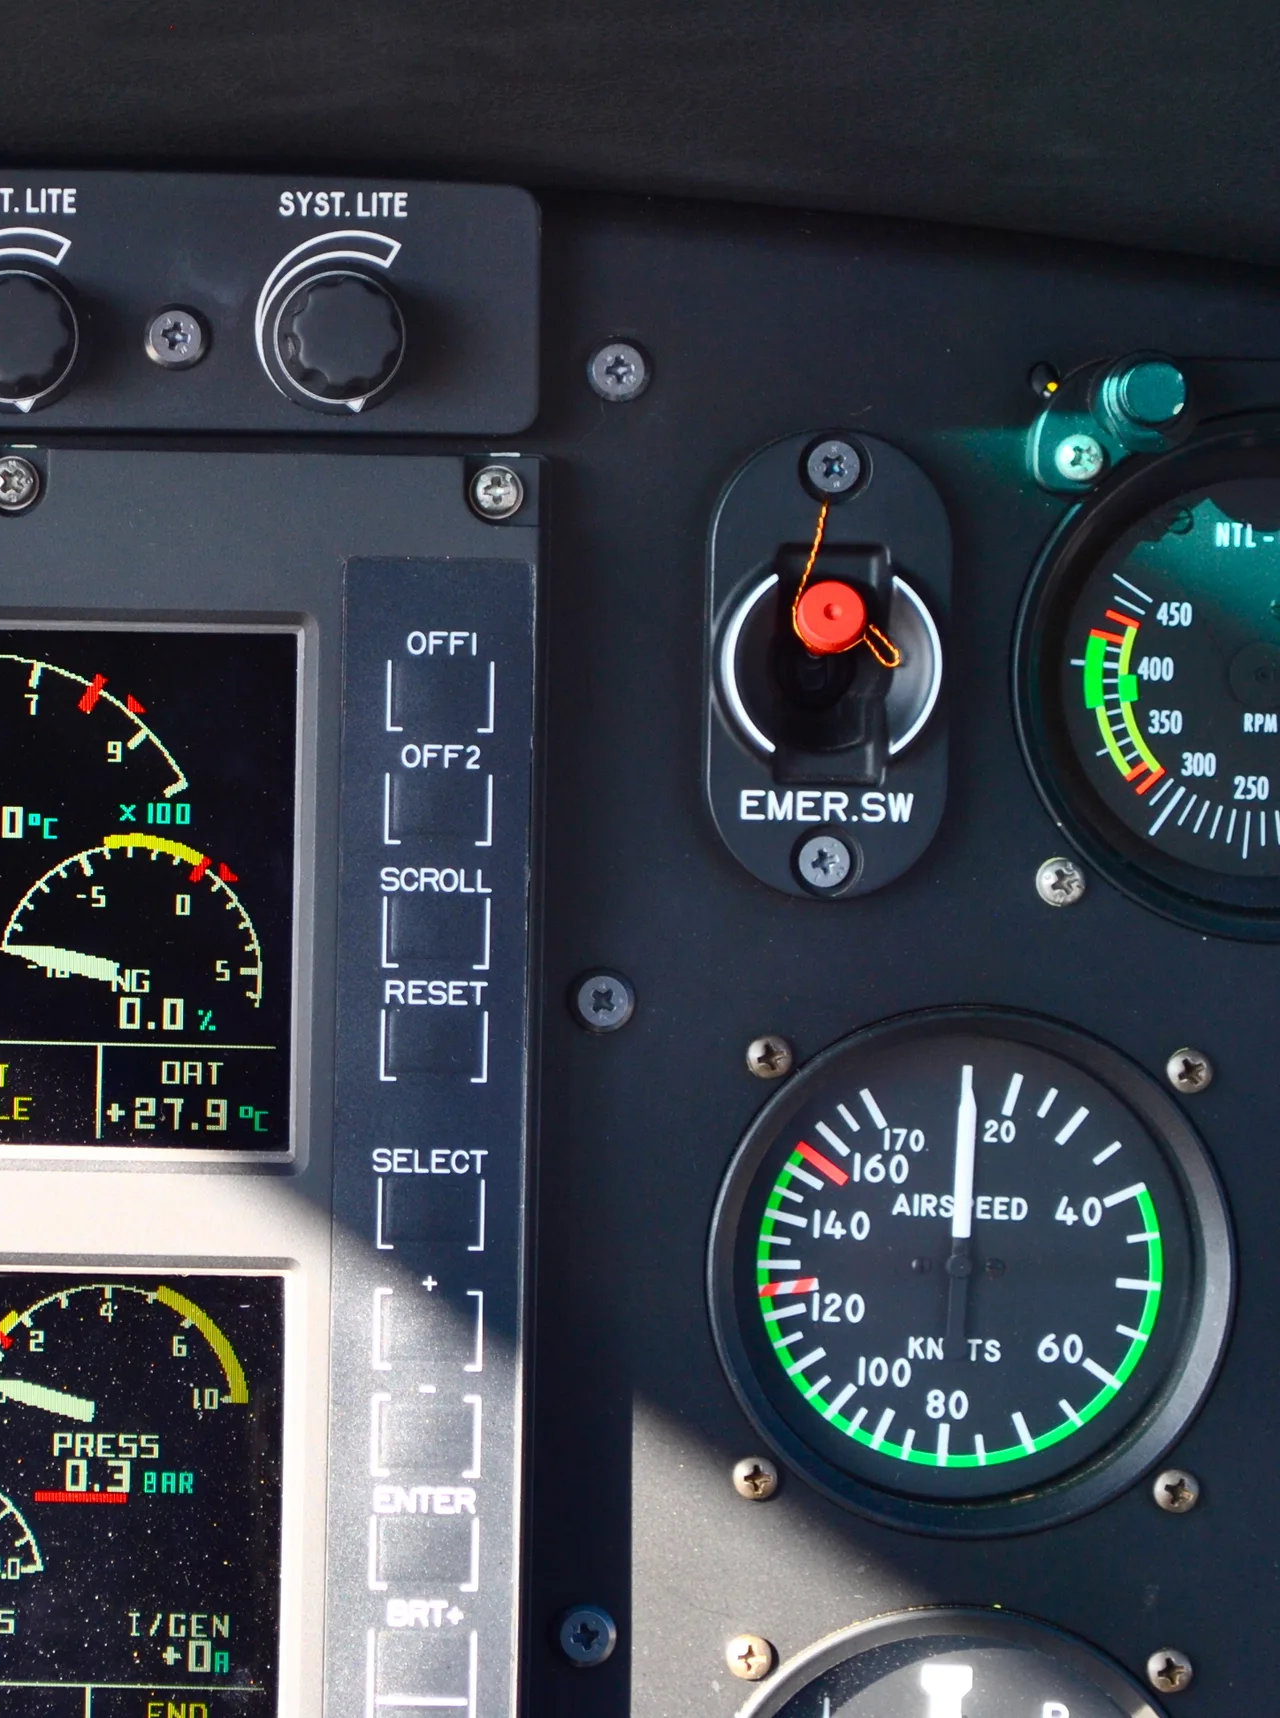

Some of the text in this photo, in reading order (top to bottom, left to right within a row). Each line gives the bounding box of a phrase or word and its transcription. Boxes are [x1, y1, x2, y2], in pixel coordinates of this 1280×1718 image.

[1215, 522, 1257, 548] NTL
[1156, 602, 1192, 627] 450
[1137, 657, 1174, 681] 400
[24, 695, 38, 716] 7
[1148, 710, 1183, 735] 350
[1243, 713, 1278, 734] RPM
[107, 742, 122, 763] 9
[401, 744, 481, 770] OFF2
[1181, 752, 1217, 777] 300
[1233, 775, 1269, 801] 250
[740, 789, 914, 823] EMER.SW
[380, 866, 492, 893] SCROLL
[76, 886, 106, 907] -5
[175, 894, 190, 915] 0
[112, 969, 150, 992] NG
[215, 960, 230, 981] 5
[384, 980, 488, 1006] RESET
[120, 997, 184, 1030] 0.0
[160, 1060, 224, 1086] OAT
[883, 1127, 926, 1152] 170
[984, 1120, 1016, 1143] 20
[372, 1148, 488, 1174] SELECT
[853, 1154, 910, 1183] 160
[892, 1193, 1028, 1221] AIRSEED
[1055, 1196, 1103, 1228] 40
[812, 1210, 870, 1240] 140
[100, 1301, 114, 1323] 4
[811, 1293, 865, 1324] 120
[29, 1330, 44, 1352] 2
[173, 1335, 187, 1358] 6
[908, 1335, 1002, 1363] KNTS
[1037, 1334, 1083, 1364] 60
[857, 1357, 912, 1388] 100
[925, 1389, 969, 1420] 80
[53, 1432, 159, 1459] PRESS
[66, 1459, 194, 1495] 0.3 BAR
[373, 1486, 476, 1515] ENTER
[128, 1613, 229, 1638] I/GEN
